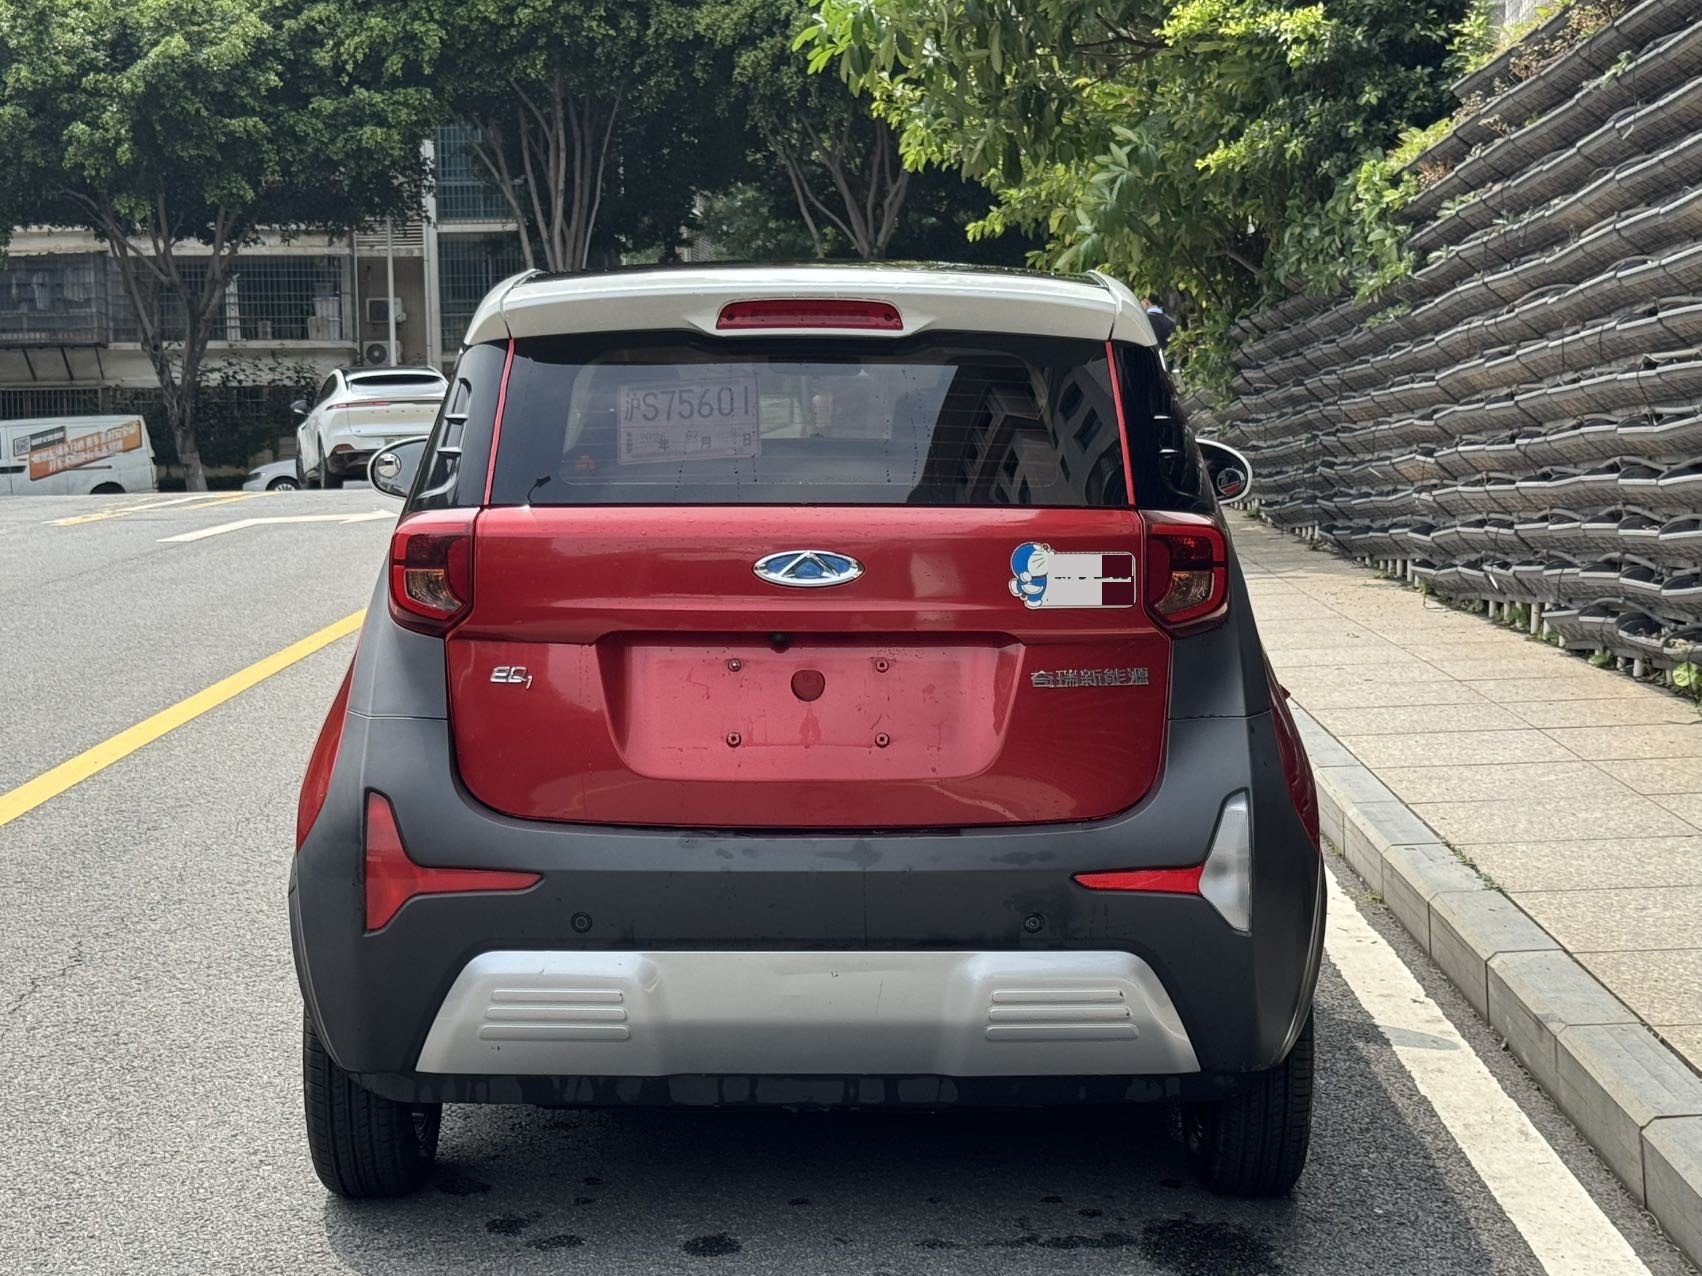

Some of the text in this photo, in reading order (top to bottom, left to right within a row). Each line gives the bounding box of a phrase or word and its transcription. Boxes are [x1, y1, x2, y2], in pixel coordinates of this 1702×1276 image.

[1031, 668, 1149, 688] 奇瑞新能源
